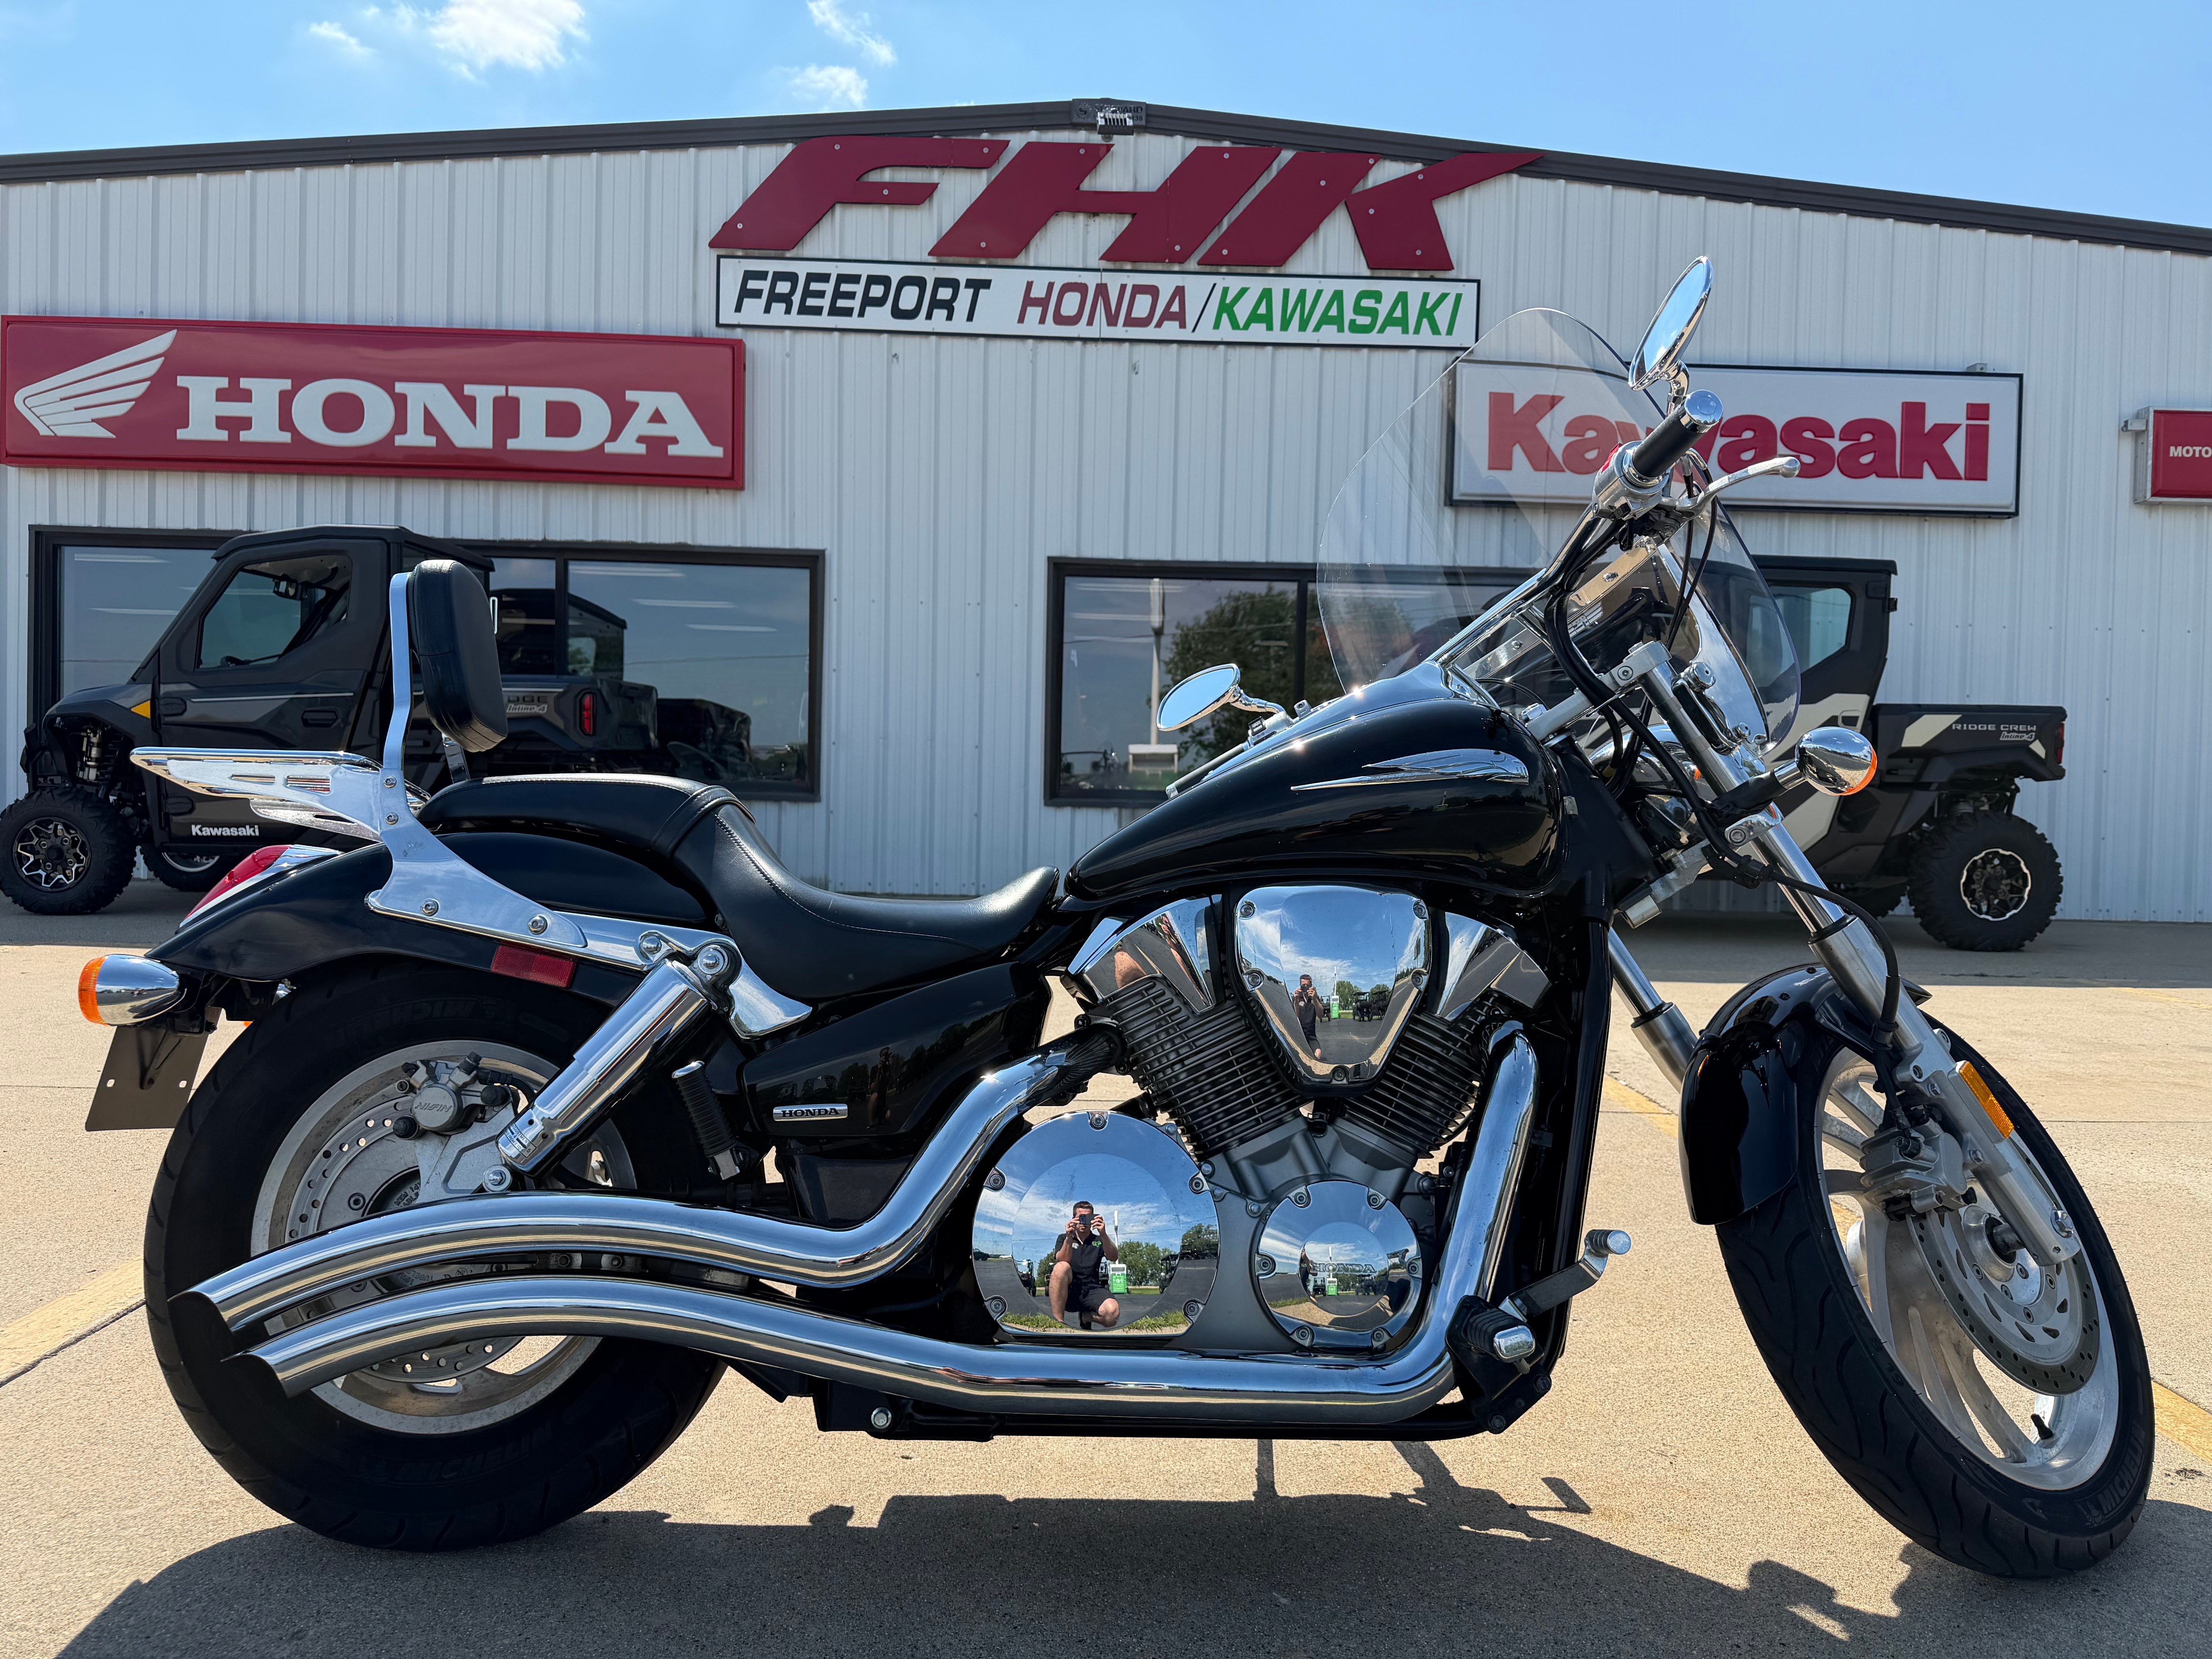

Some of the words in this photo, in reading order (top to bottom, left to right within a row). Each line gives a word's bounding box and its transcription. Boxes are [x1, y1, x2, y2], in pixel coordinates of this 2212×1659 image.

[708, 135, 1544, 270] FHK
[734, 270, 991, 322] FREEPORT
[177, 375, 724, 458] HONDA
[191, 824, 259, 836] Kawasaki
[781, 1108, 840, 1118] HONDA
[400, 1192, 419, 1207] ABLE
[1310, 1262, 1377, 1274] HONDA
[2097, 1419, 2146, 1515] MICHELIN
